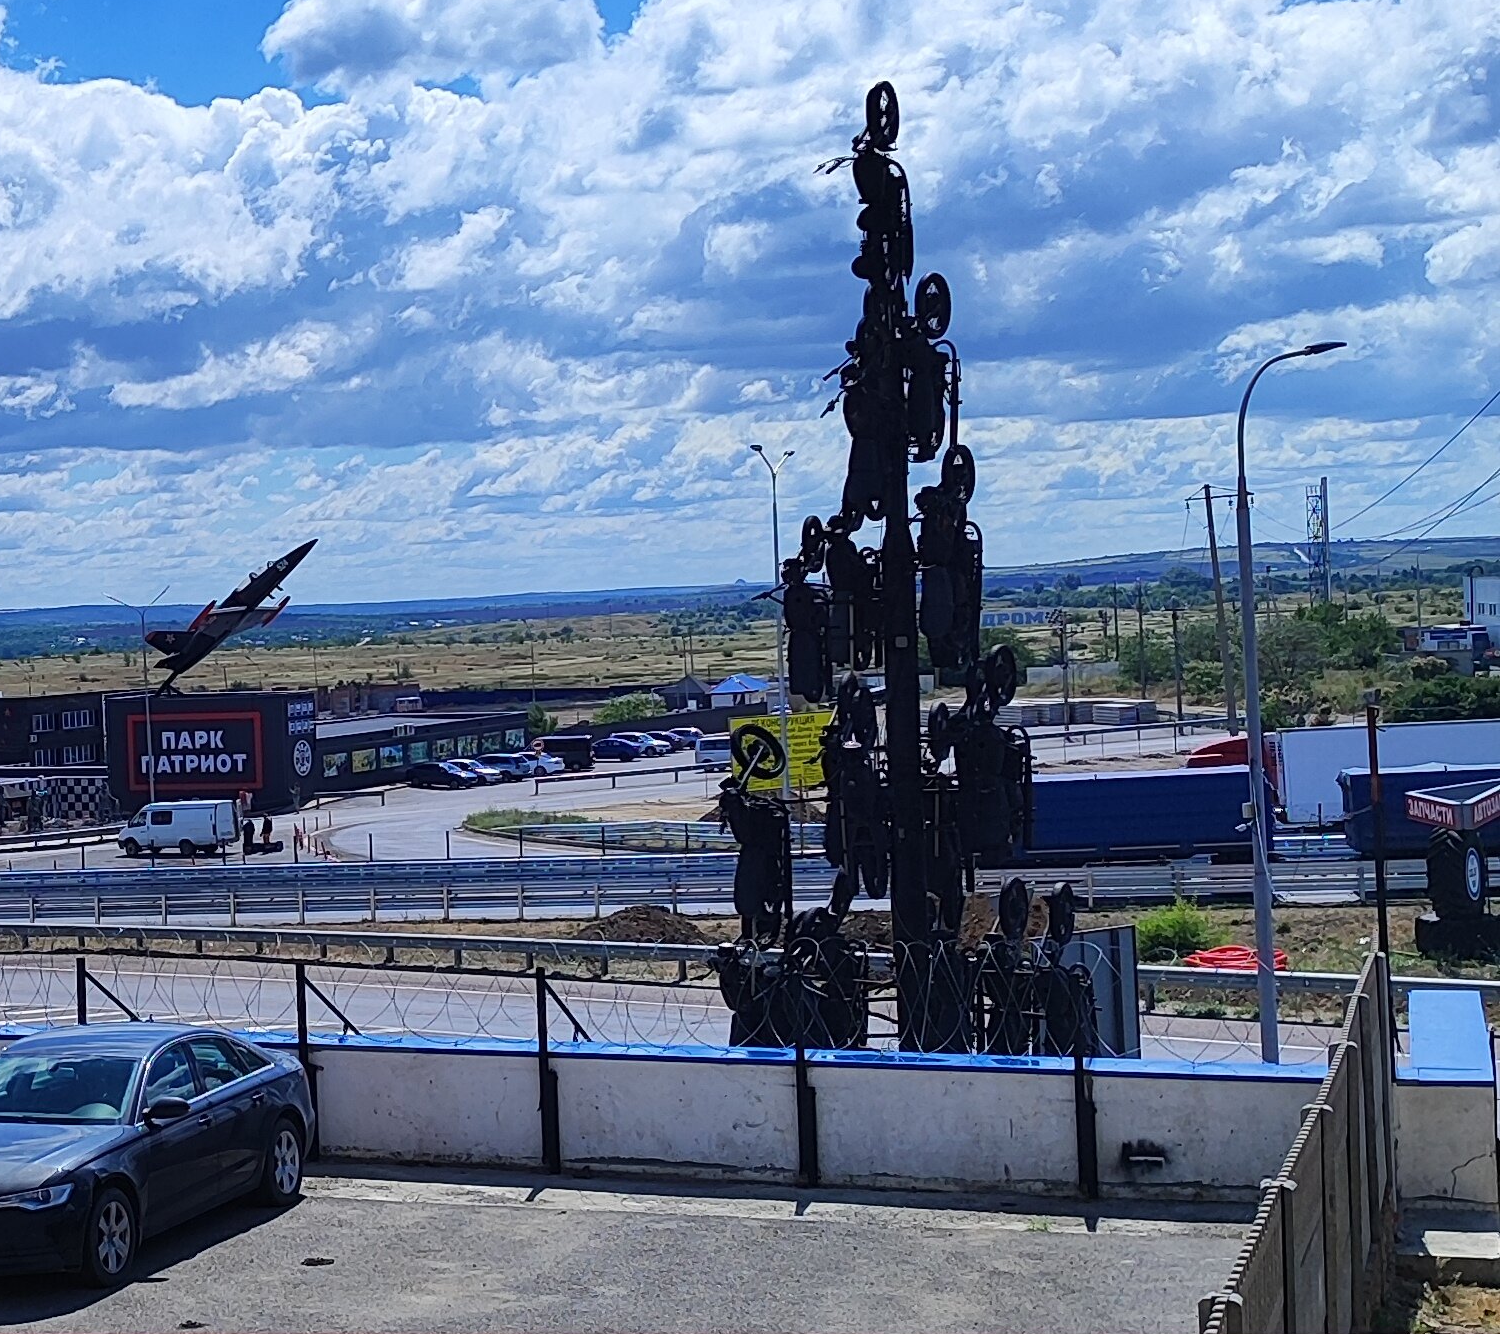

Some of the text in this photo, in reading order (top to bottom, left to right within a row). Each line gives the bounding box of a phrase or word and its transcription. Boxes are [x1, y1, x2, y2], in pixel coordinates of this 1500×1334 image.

[161, 730, 225, 750] ПАРК
[140, 753, 247, 774] ПАТРИОТ
[1407, 798, 1454, 826] ЗАПЧАСТИ
[1473, 793, 1500, 824] АВТОЗА
